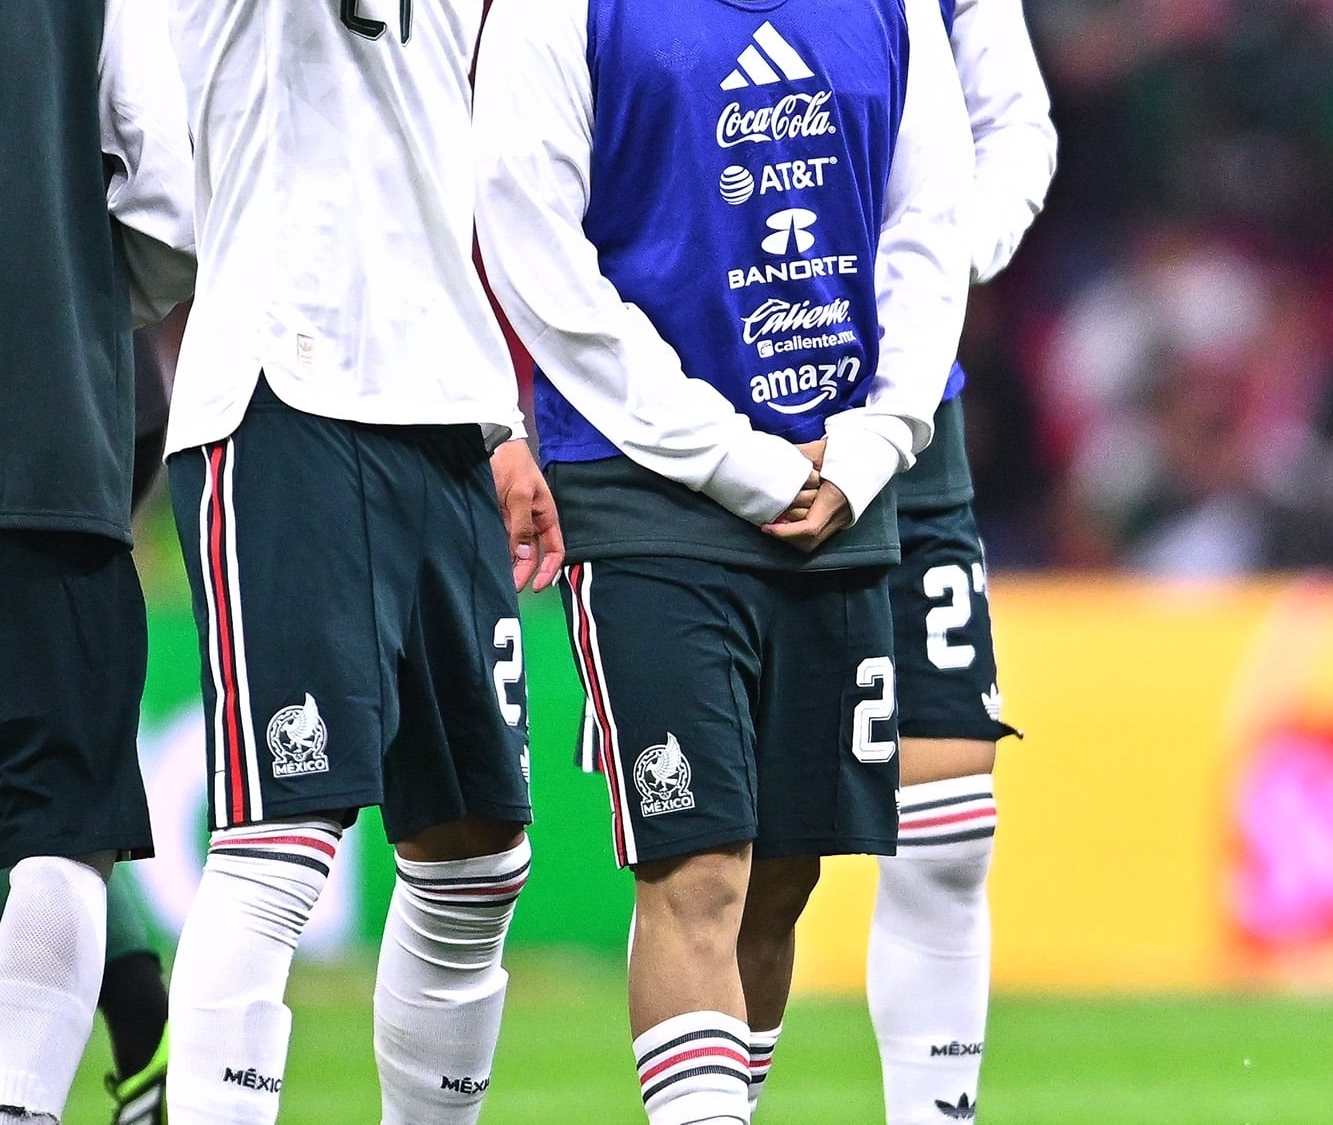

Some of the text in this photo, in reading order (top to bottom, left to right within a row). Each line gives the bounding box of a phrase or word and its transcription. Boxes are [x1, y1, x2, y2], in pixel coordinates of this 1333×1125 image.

[760, 157, 830, 194] AT&T
[728, 255, 858, 290] BANORTE
[774, 330, 857, 354] caliente.mx
[750, 355, 861, 404] amazn
[852, 656, 897, 764] 2
[275, 759, 325, 775] MÉXICO
[643, 796, 691, 815] MÉXICO
